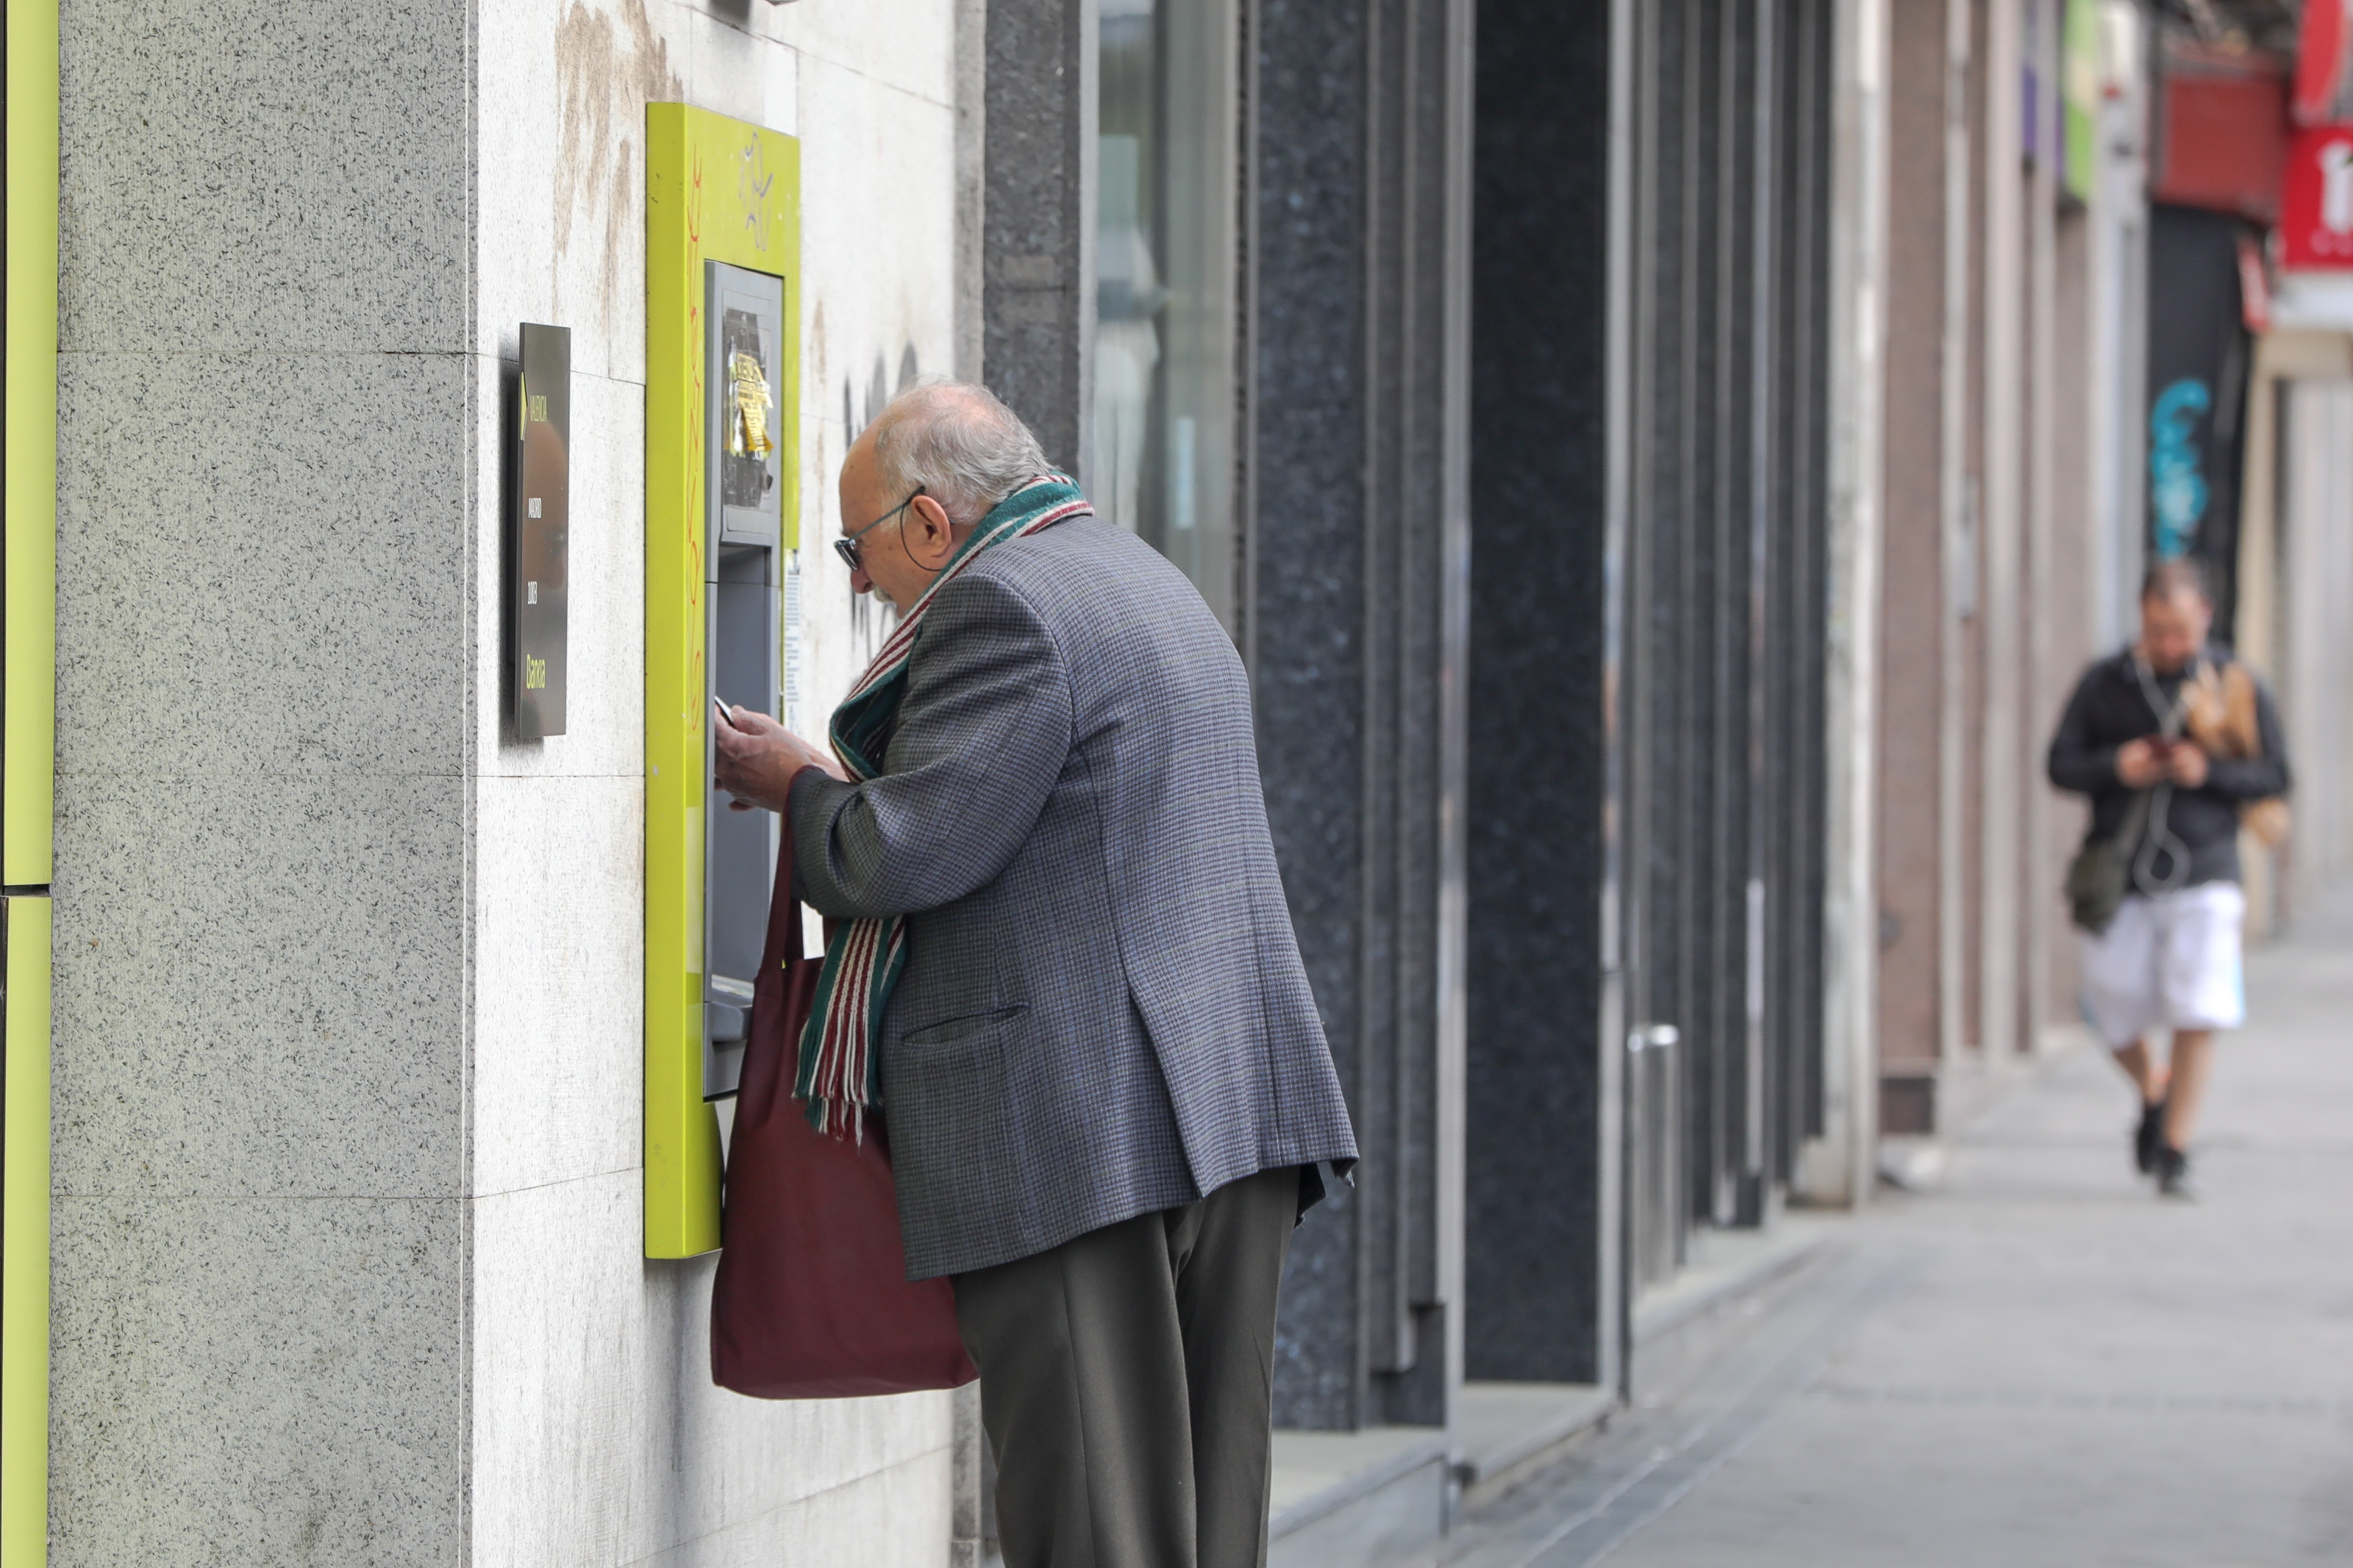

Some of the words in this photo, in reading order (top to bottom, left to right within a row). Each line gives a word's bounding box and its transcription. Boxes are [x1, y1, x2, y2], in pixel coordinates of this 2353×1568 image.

[529, 395, 547, 421] VALENCIA
[528, 498, 541, 518] MADRID
[527, 581, 538, 604] 1003
[526, 654, 545, 689] Bankia
